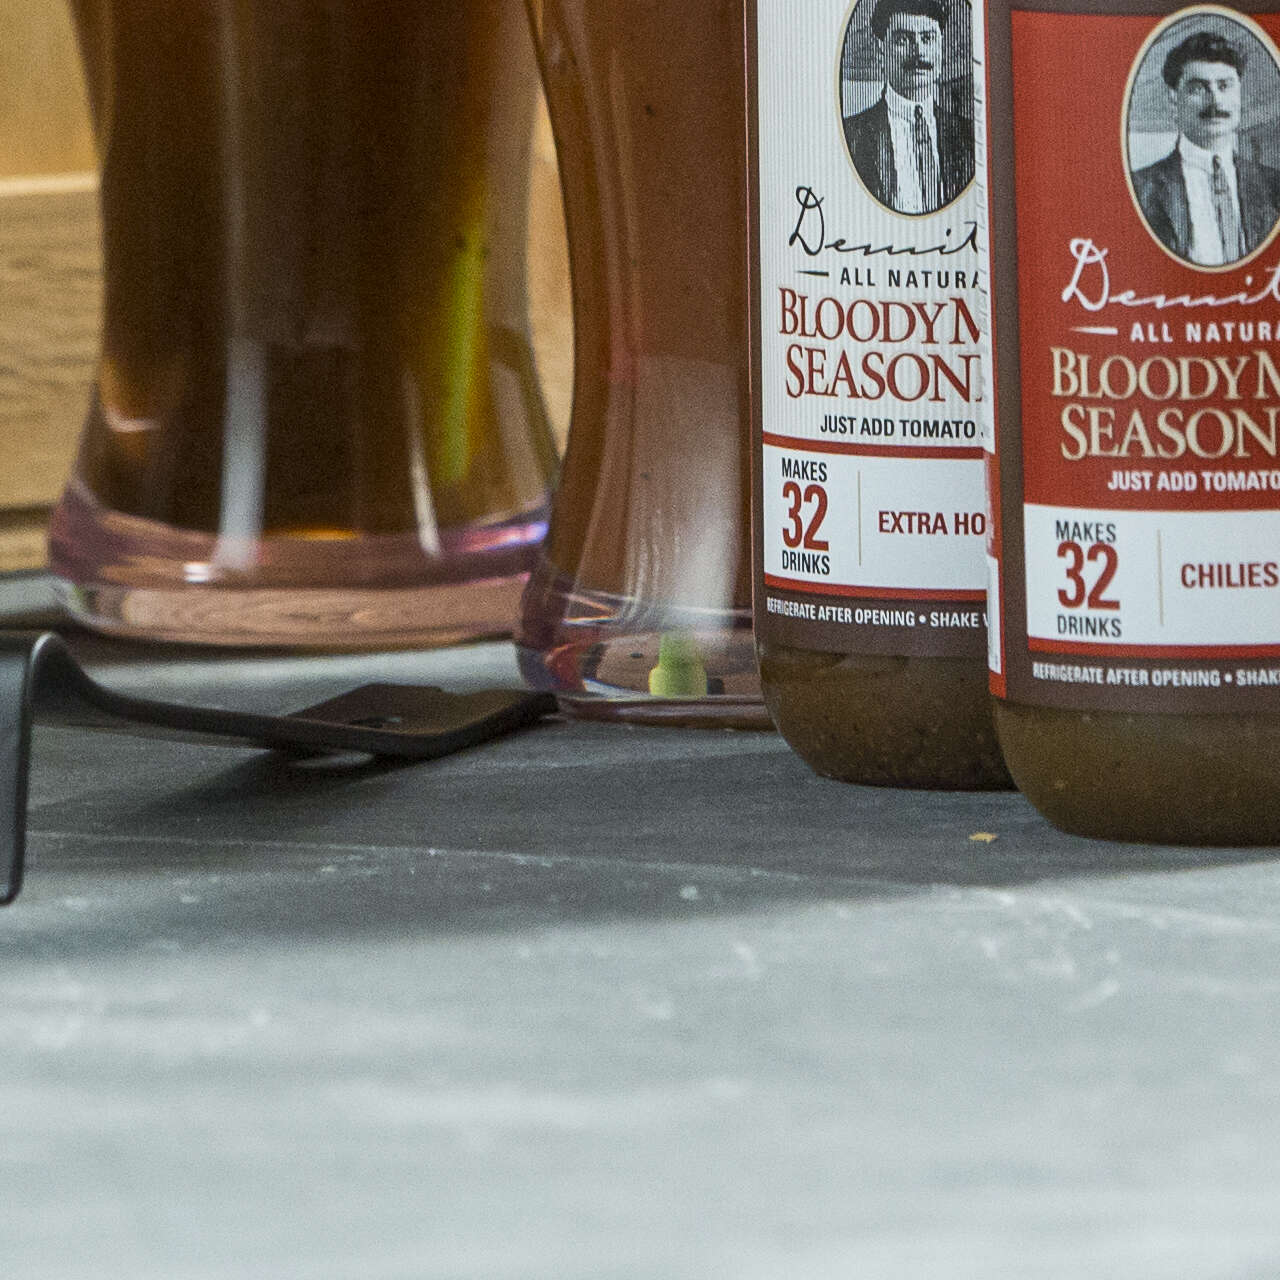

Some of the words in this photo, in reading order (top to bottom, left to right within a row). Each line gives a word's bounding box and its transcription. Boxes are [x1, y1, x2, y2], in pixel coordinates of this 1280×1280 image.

[840, 267, 876, 287] ALL
[1130, 322, 1173, 343] ALL
[786, 344, 983, 402] SEASON
[820, 415, 856, 435] JUST
[861, 417, 894, 437] ADD
[900, 419, 977, 440] TOMATO
[781, 457, 828, 483] MAKES
[1107, 469, 1152, 492] JUST
[1157, 469, 1199, 491] ADD
[782, 481, 829, 552] 32
[878, 510, 948, 535] EXTRA
[954, 512, 987, 536] HO
[1055, 519, 1117, 543] MAKES
[781, 550, 831, 576] DRINKS
[1056, 540, 1120, 611] 32
[1181, 562, 1280, 589] CHILIES
[767, 597, 816, 621] REFRIGERATE
[818, 604, 853, 625] AFTER
[855, 608, 916, 627] OPENING
[930, 611, 979, 628] SHAKE
[1057, 614, 1122, 639] DRINKS
[1032, 663, 1104, 686] REFRIGERATE
[1107, 665, 1149, 687] AFTER
[1152, 666, 1221, 687] OPENING
